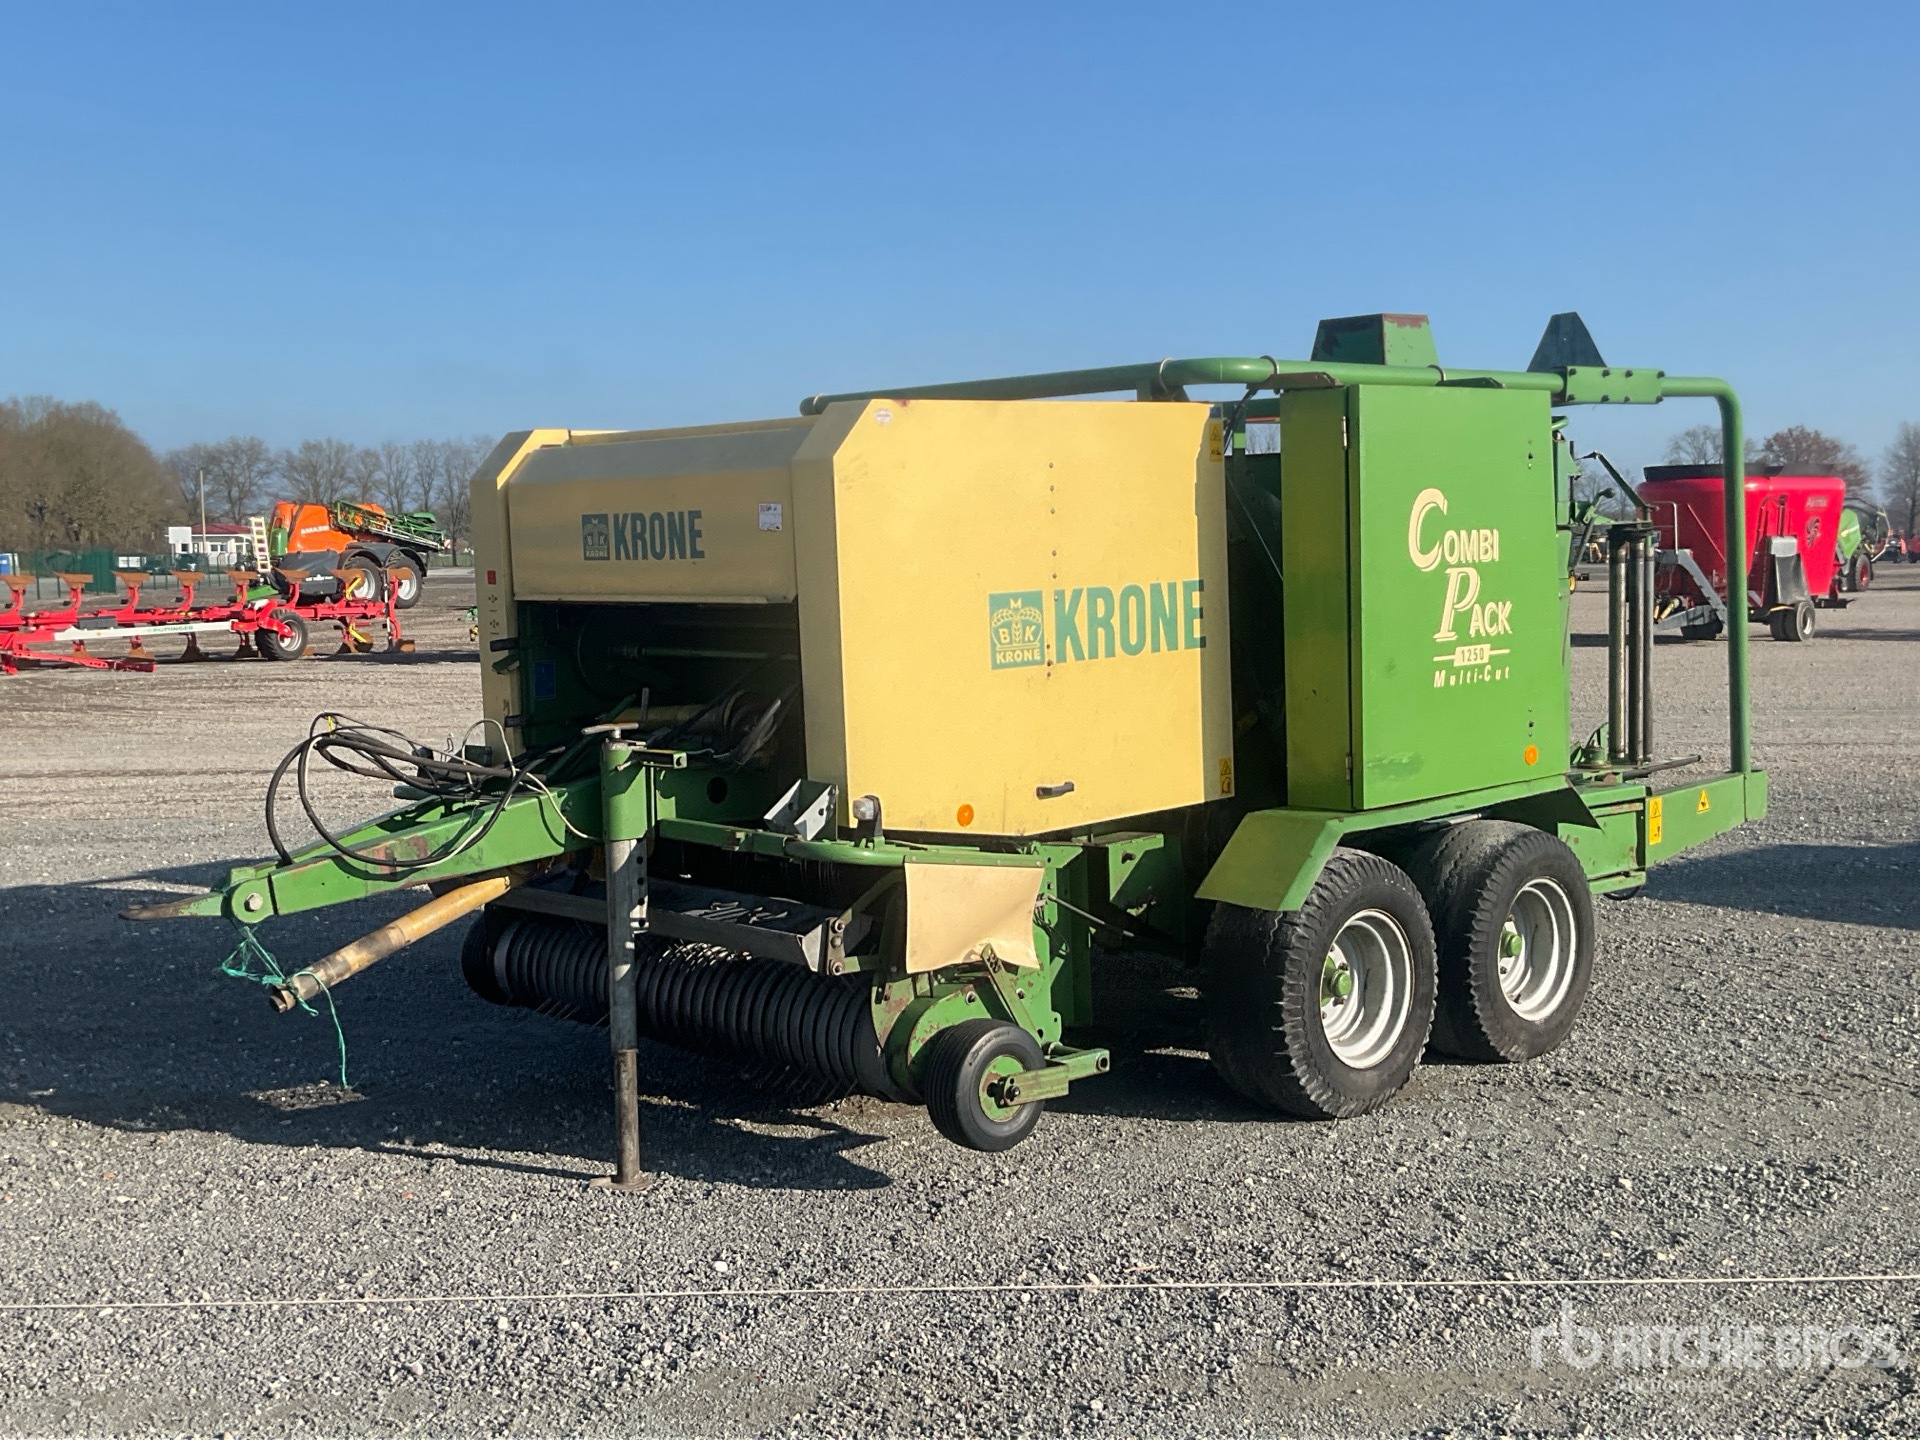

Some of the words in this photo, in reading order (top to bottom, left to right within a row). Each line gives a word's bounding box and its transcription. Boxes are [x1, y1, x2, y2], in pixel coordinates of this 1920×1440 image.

[613, 510, 705, 560] KRONE
[586, 550, 608, 558] KRONE
[1010, 597, 1022, 610] M
[1053, 579, 1206, 663] KRONE
[999, 628, 1010, 644] B
[1024, 625, 1037, 641] K
[996, 650, 1041, 664] KRONE
[1461, 648, 1485, 662] 1250
[1434, 665, 1510, 688] Multi-Cut
